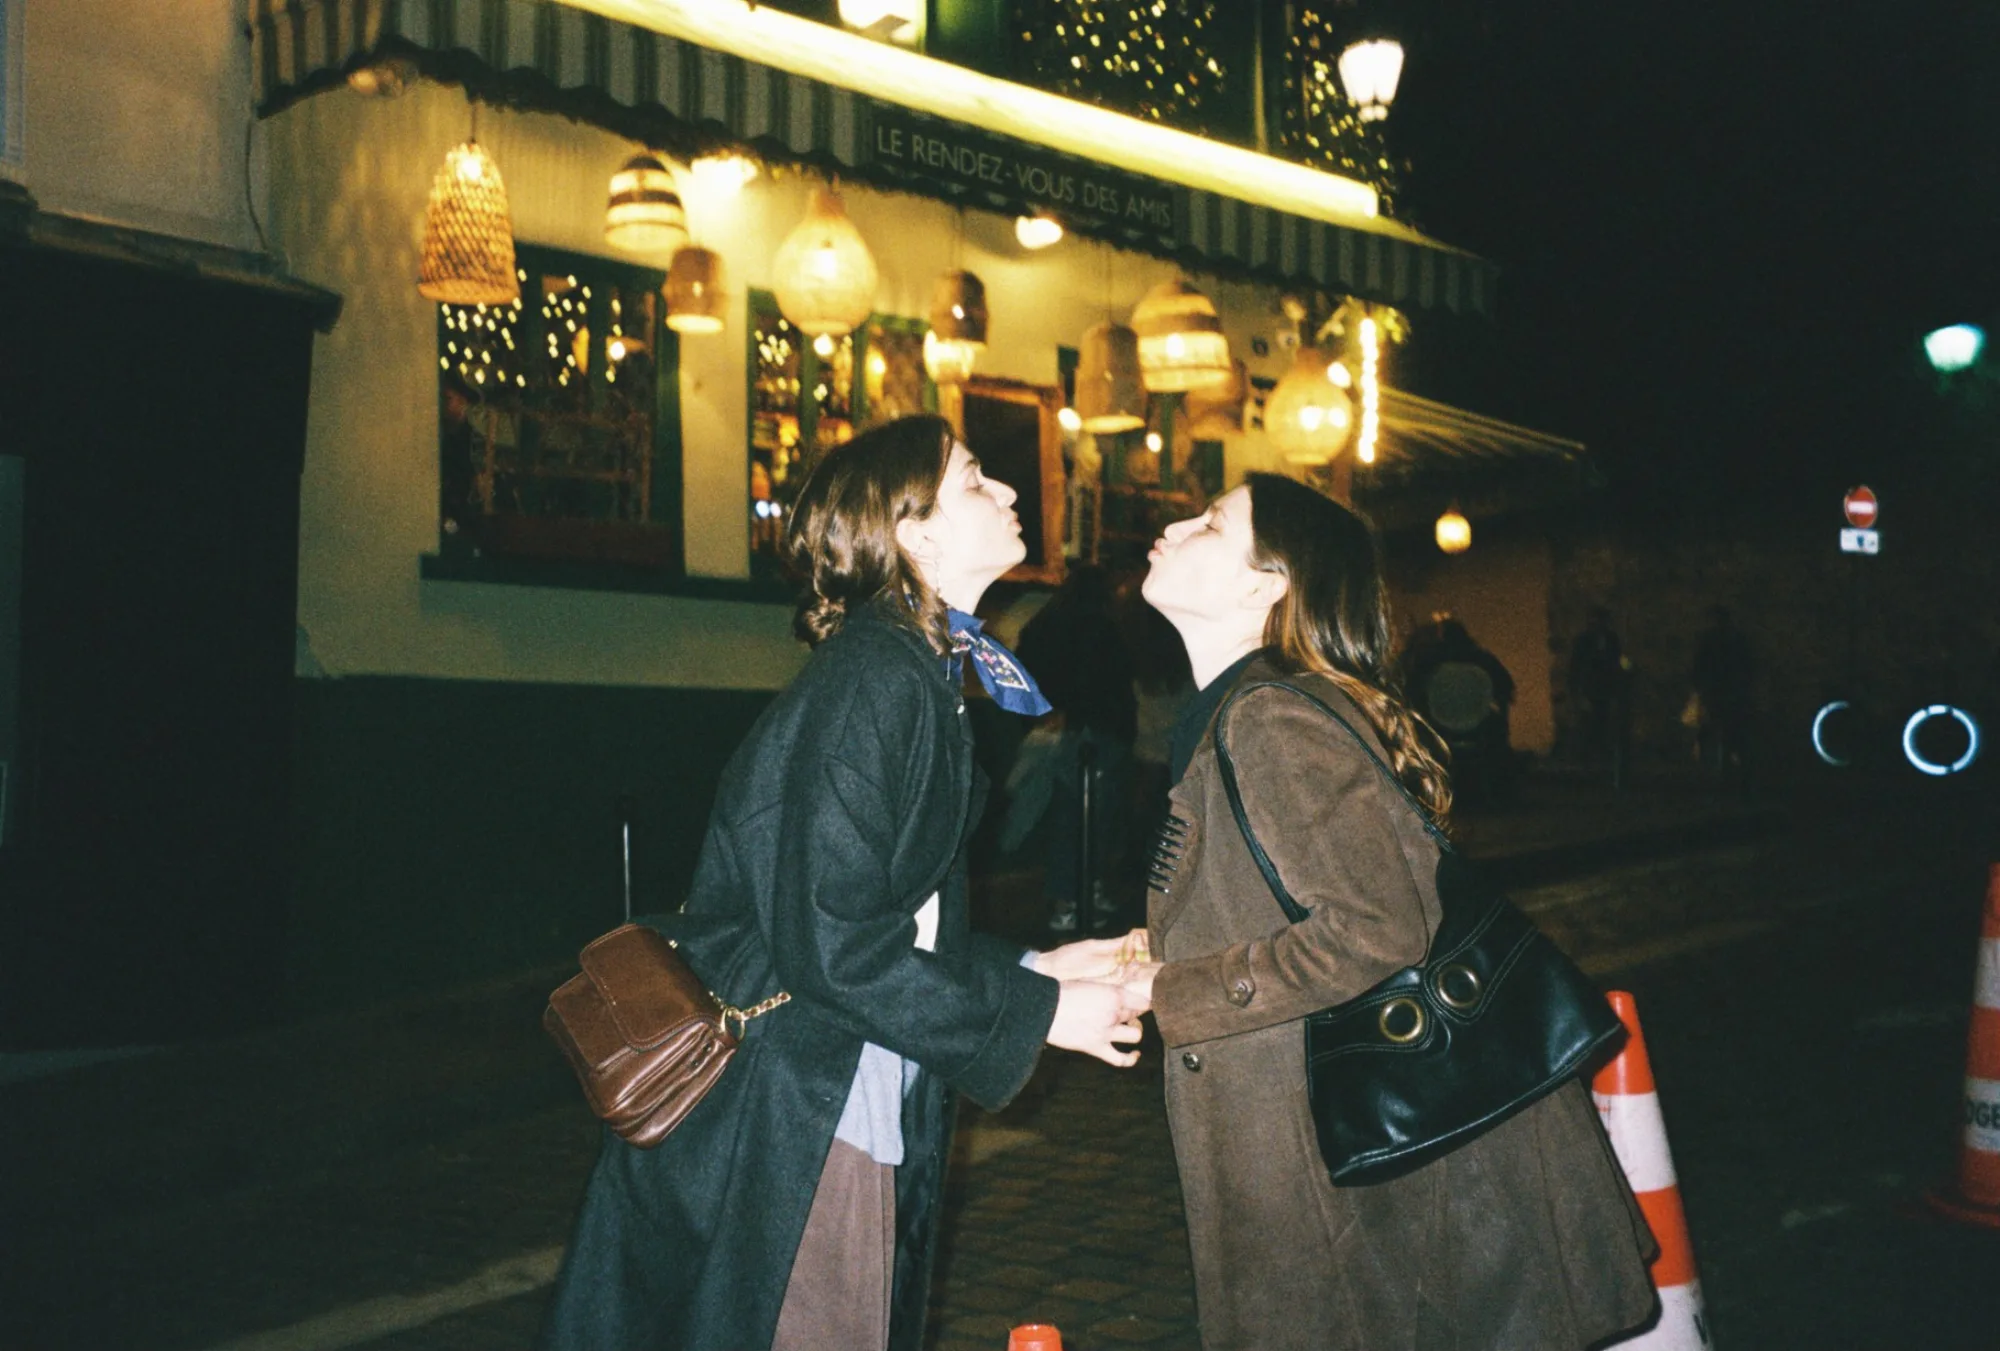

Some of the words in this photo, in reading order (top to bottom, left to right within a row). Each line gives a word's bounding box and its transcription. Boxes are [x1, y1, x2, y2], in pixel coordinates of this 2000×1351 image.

[876, 125, 903, 158] LE
[911, 134, 1076, 202] RENDEZ-VOUS
[1083, 182, 1119, 214] DES
[1125, 196, 1171, 228] AMIS
